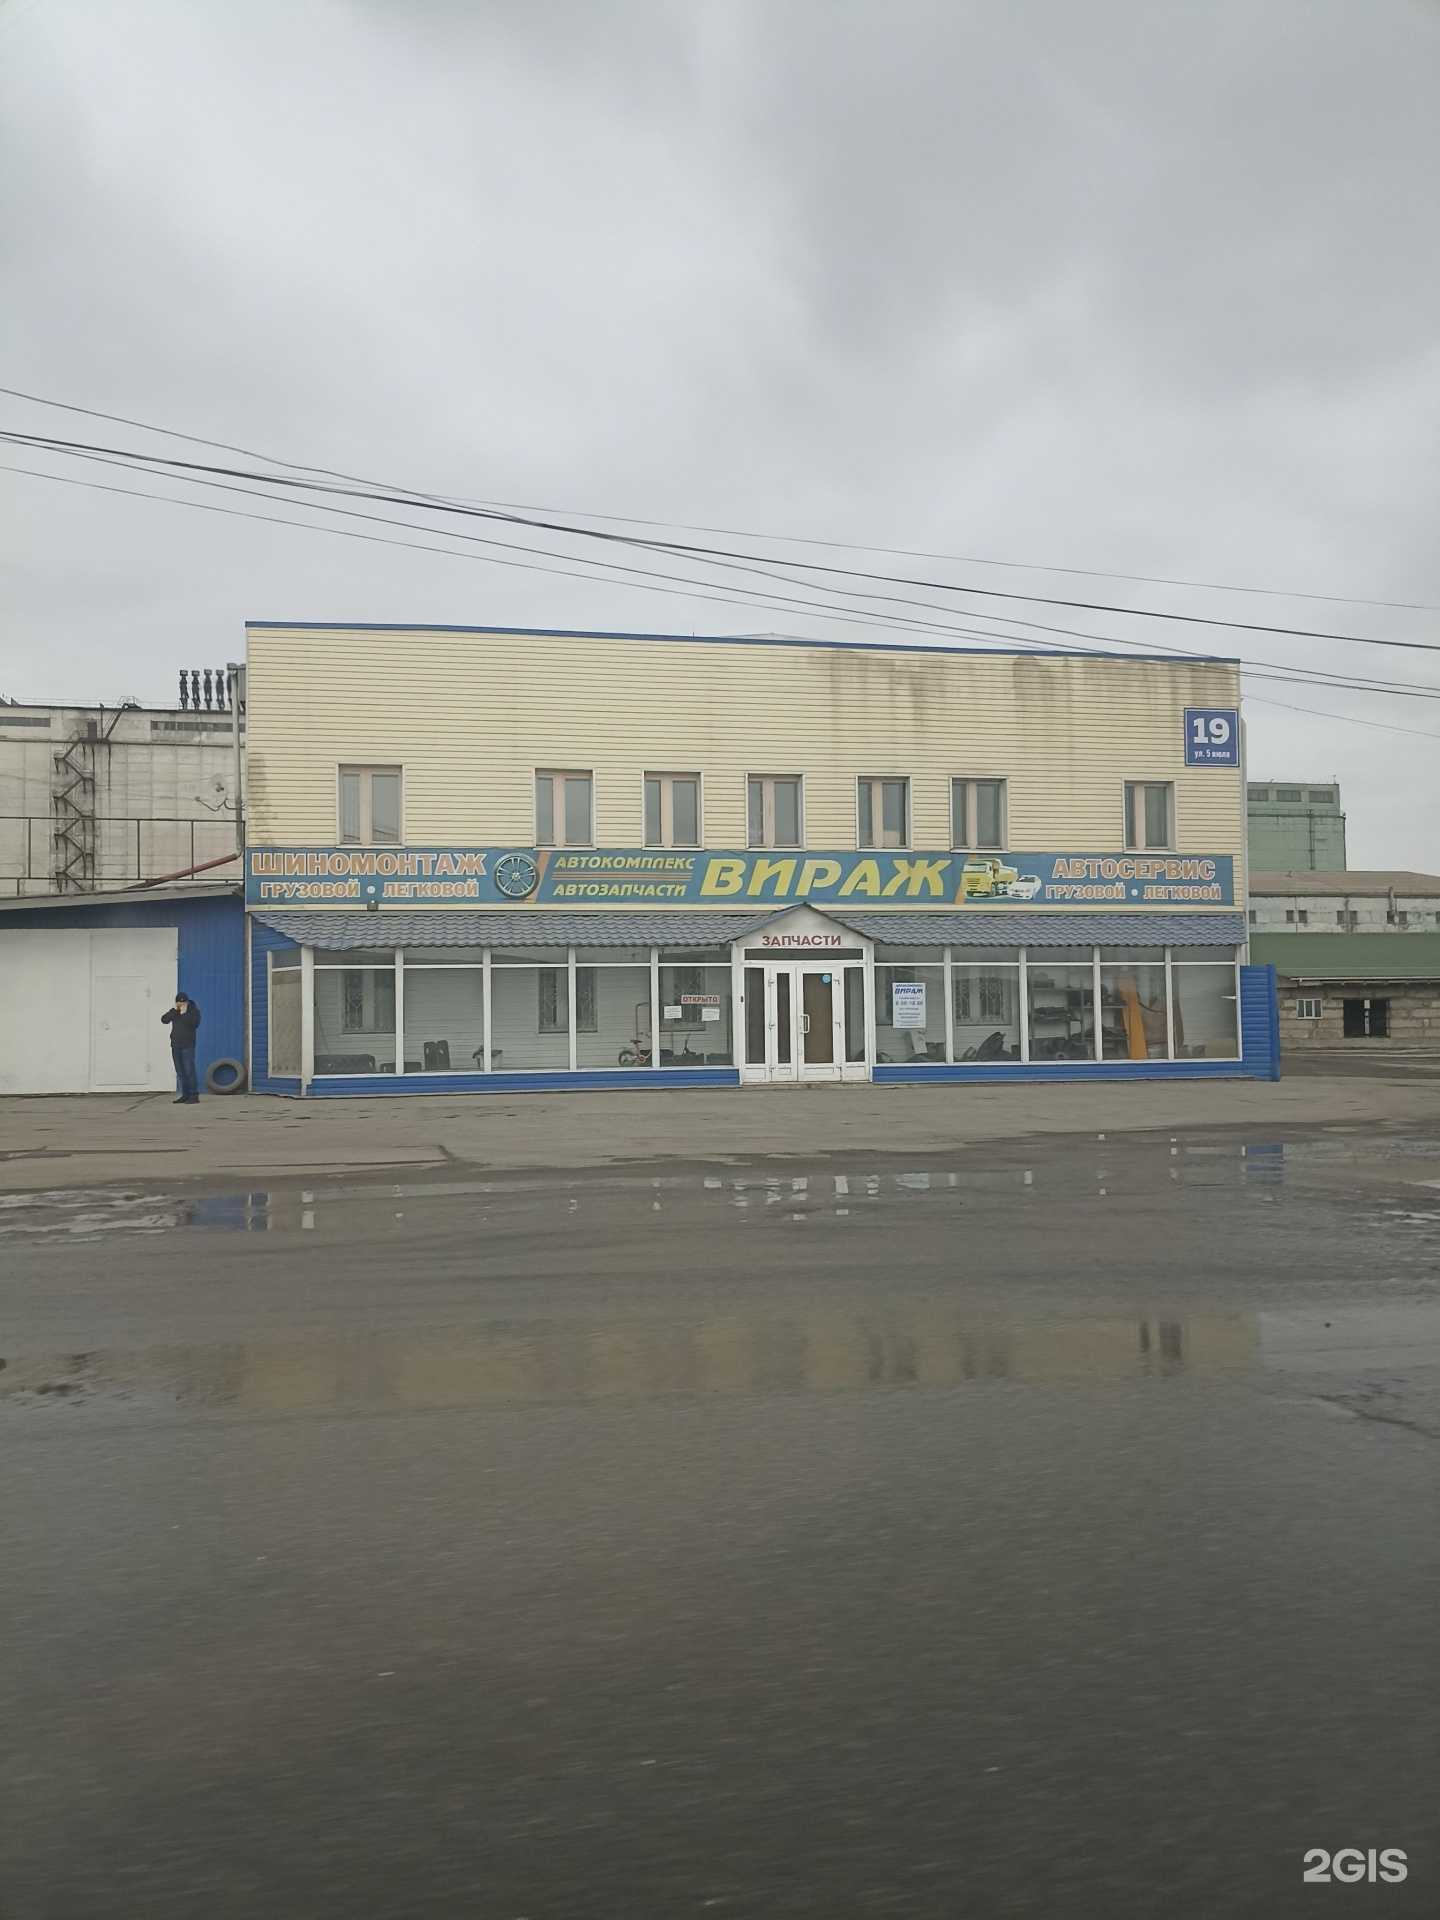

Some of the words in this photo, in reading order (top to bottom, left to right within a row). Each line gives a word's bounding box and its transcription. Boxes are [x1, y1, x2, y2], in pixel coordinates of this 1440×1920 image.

[1193, 717, 1230, 745] 19
[1194, 751, 1205, 760] ул.
[251, 852, 488, 876] ШИНОМОНТАЖ
[554, 856, 695, 869] АВТОКОМПЛЕКС
[1052, 858, 1216, 880] АВТОСЕРВИС
[700, 858, 952, 897] ВИРАЖ
[260, 878, 361, 898] ГРУЗОВОЙ
[382, 878, 479, 898] ЛЕГКОВОЙ
[553, 884, 687, 897] АВТОЗАПЧАСТИ
[1045, 882, 1126, 900] ГРУЗОВОЙ
[1143, 883, 1221, 900] ЛЕГКОВОЙ
[762, 935, 842, 947] ЗАПЧАСТИ
